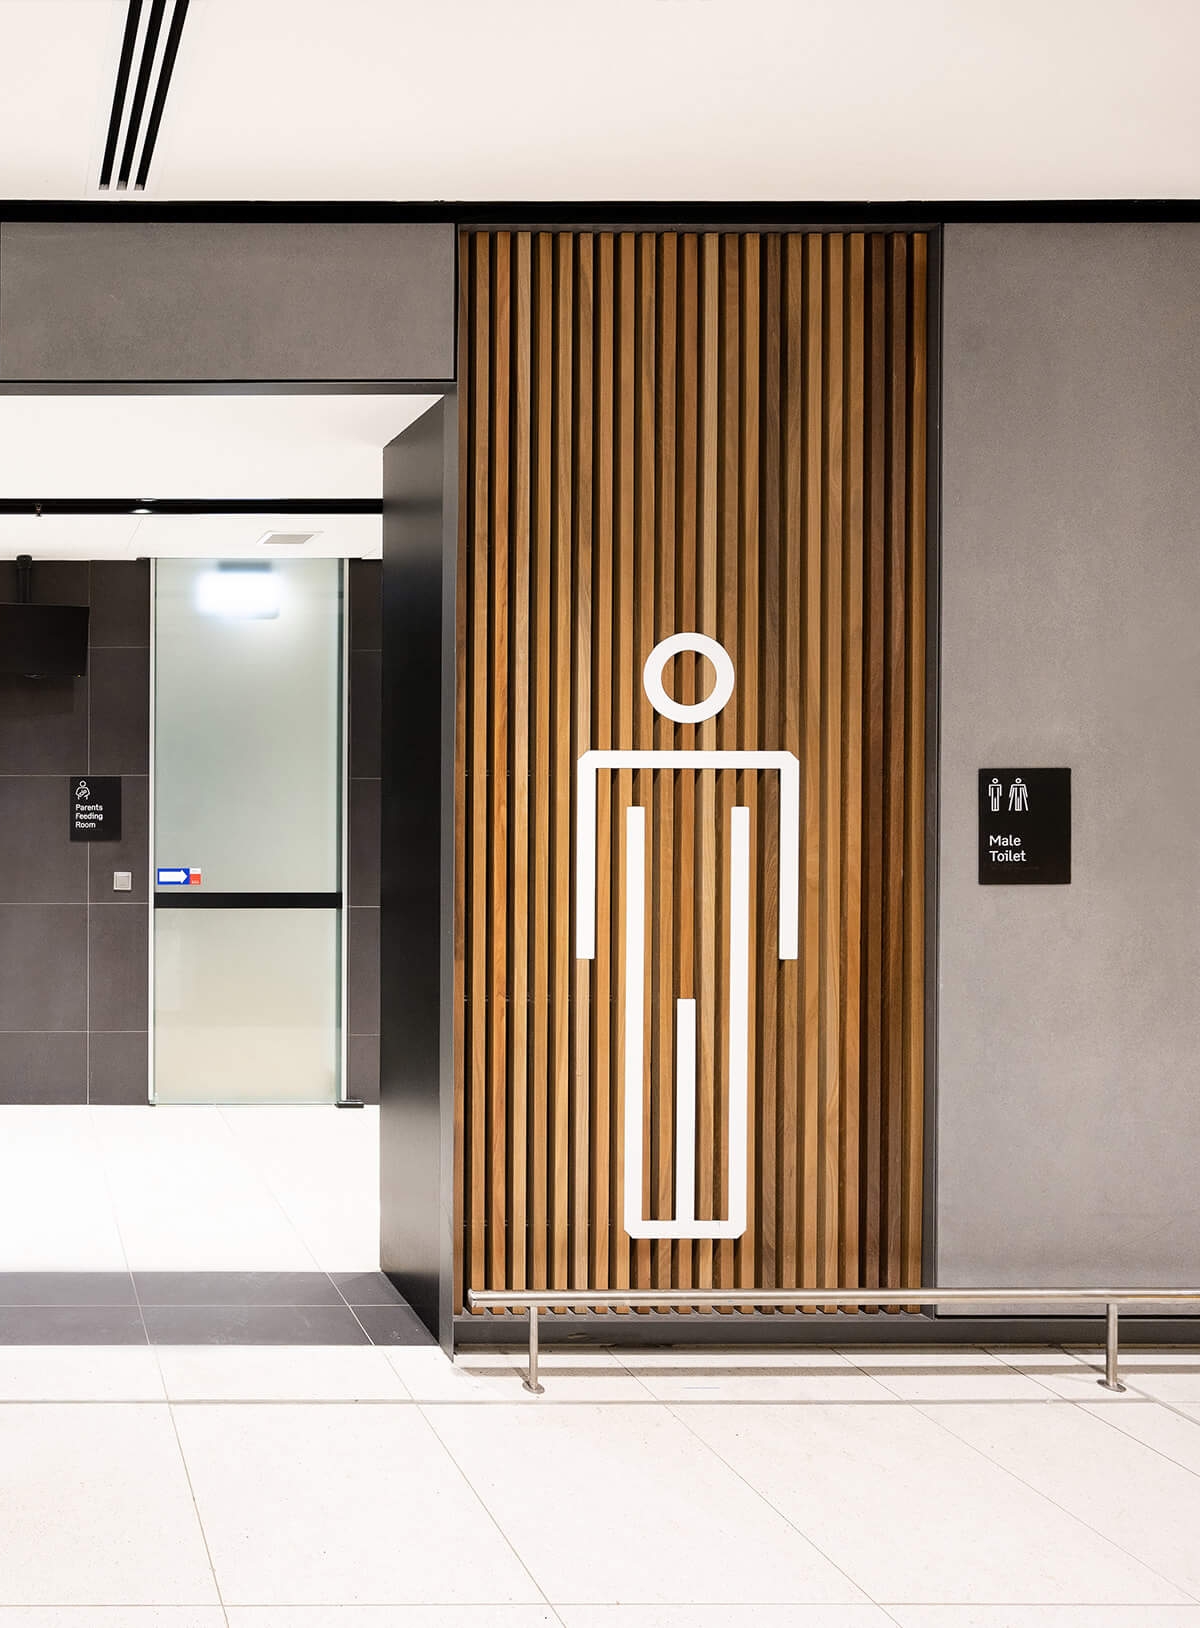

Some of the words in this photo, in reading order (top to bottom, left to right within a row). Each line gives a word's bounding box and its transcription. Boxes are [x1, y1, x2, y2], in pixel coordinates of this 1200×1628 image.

[75, 803, 104, 812] Parents
[75, 812, 104, 822] Feeding
[75, 821, 96, 829] Room
[988, 834, 1022, 847] Male
[988, 849, 1027, 862] Toilet
